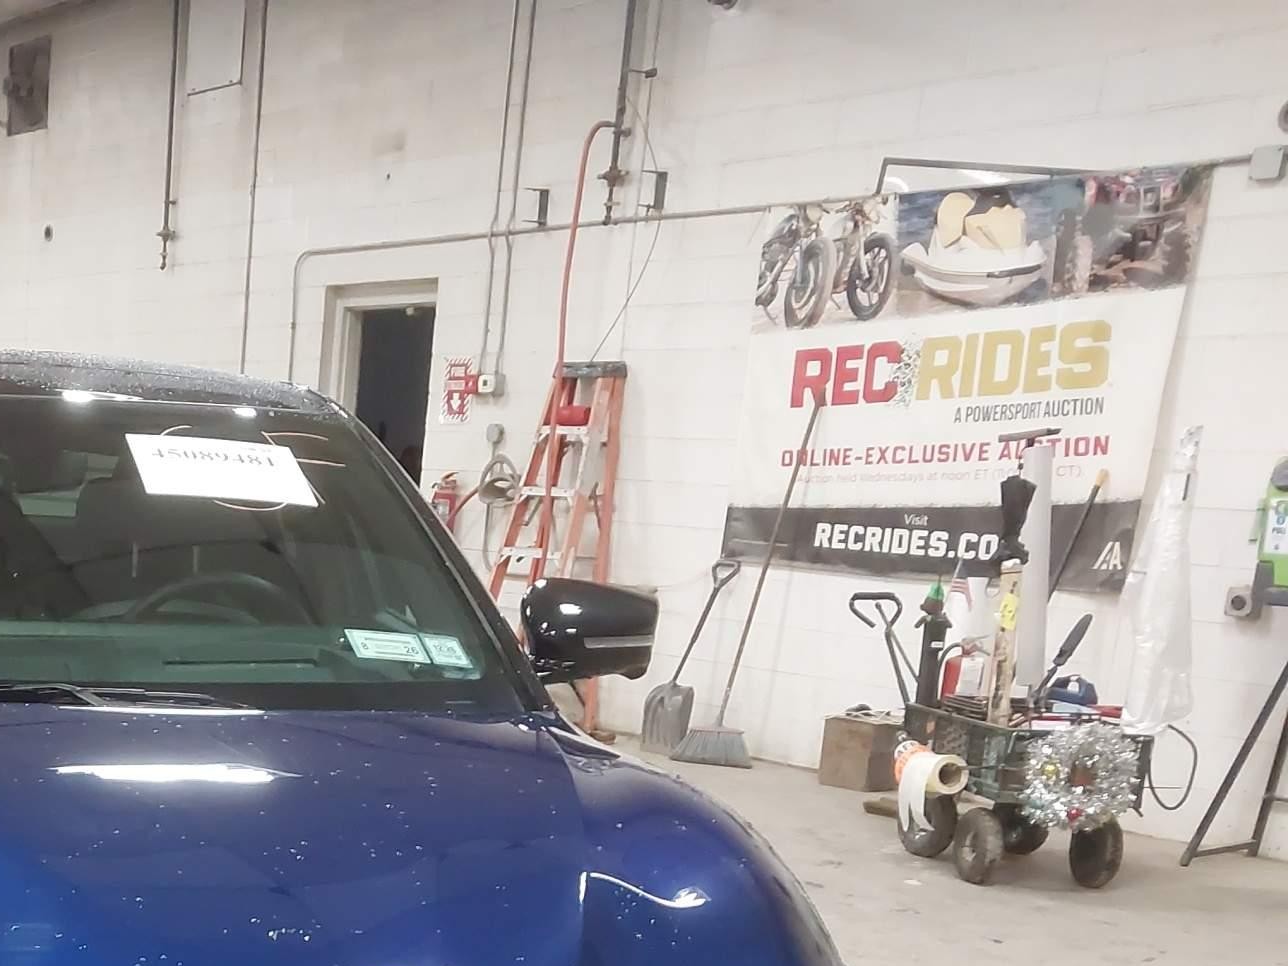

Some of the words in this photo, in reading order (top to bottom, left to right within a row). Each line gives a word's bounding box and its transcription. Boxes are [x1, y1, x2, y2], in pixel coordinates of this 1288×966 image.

[790, 340, 905, 408] REC
[915, 319, 1113, 401] RIDES
[954, 406, 962, 423] A
[965, 401, 1042, 423] POWERSPORT
[1043, 397, 1105, 418] AUCTION
[780, 443, 990, 467] ONLINE-EXCLUSIVE
[998, 435, 1110, 461] ATION
[904, 513, 929, 526] Visit
[814, 521, 1000, 561] RECRIDES.CO
